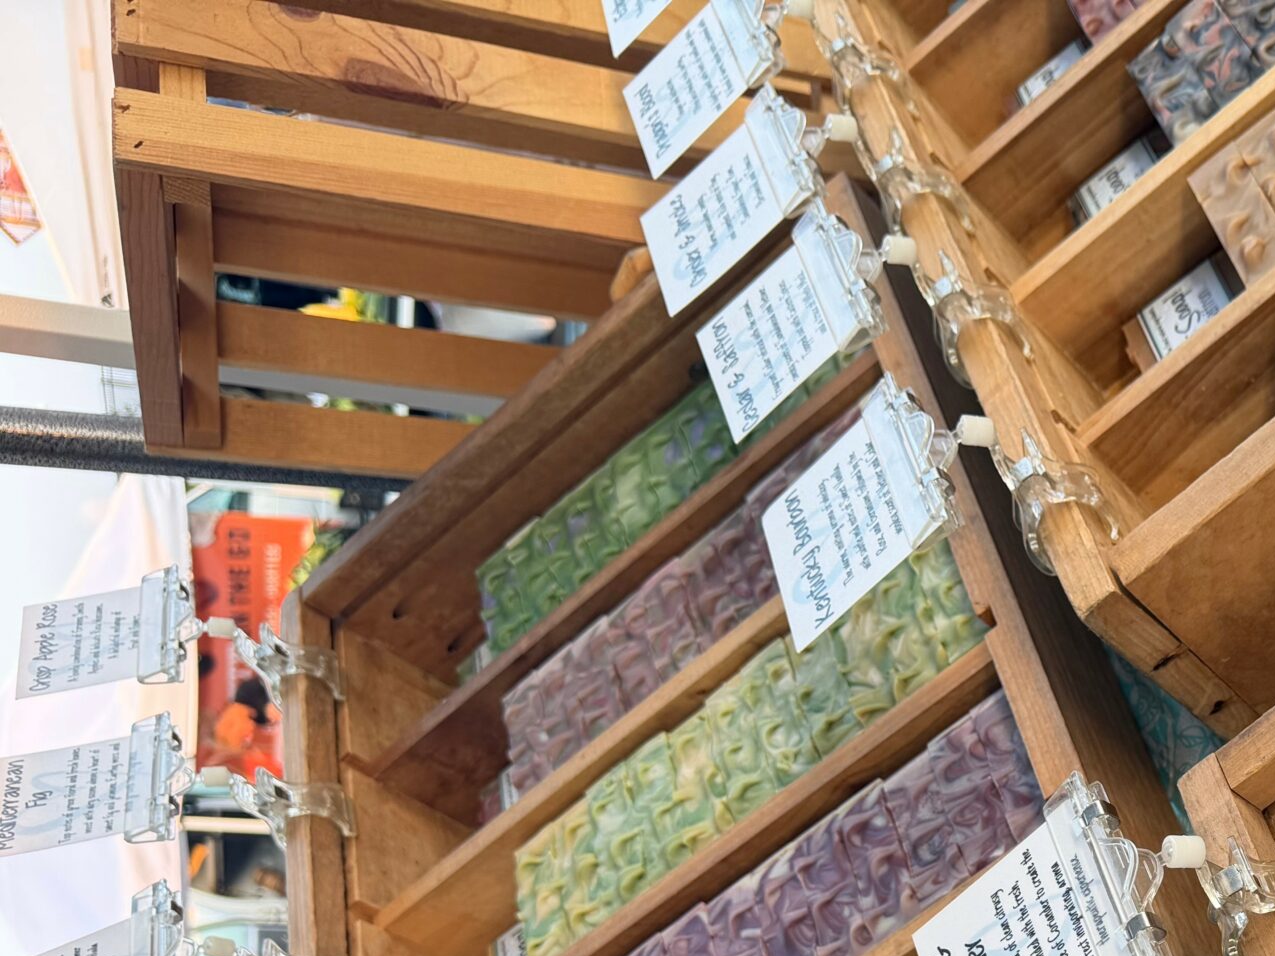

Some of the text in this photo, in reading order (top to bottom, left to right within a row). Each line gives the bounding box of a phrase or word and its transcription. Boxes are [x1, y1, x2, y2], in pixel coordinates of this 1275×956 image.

[1161, 287, 1200, 333] Soap!
[712, 317, 739, 375] Saffron
[736, 387, 759, 433] Cedar
[785, 489, 834, 629] Kentucky Bourbon
[36, 604, 58, 630] Rose
[32, 632, 58, 661] Apple
[25, 790, 53, 809] Fig
[1020, 848, 1032, 866] the
[1026, 862, 1041, 888] create
[1051, 861, 1066, 888] aroma
[990, 889, 1006, 920] citrusy
[1008, 880, 1024, 909] fresh,
[1018, 905, 1029, 922] the
[1039, 899, 1060, 943] Coriander
[1062, 886, 1085, 939] invigorating,
[1078, 896, 1110, 946] therapeutic
[1000, 918, 1013, 942] clean
[1021, 919, 1036, 939] with
